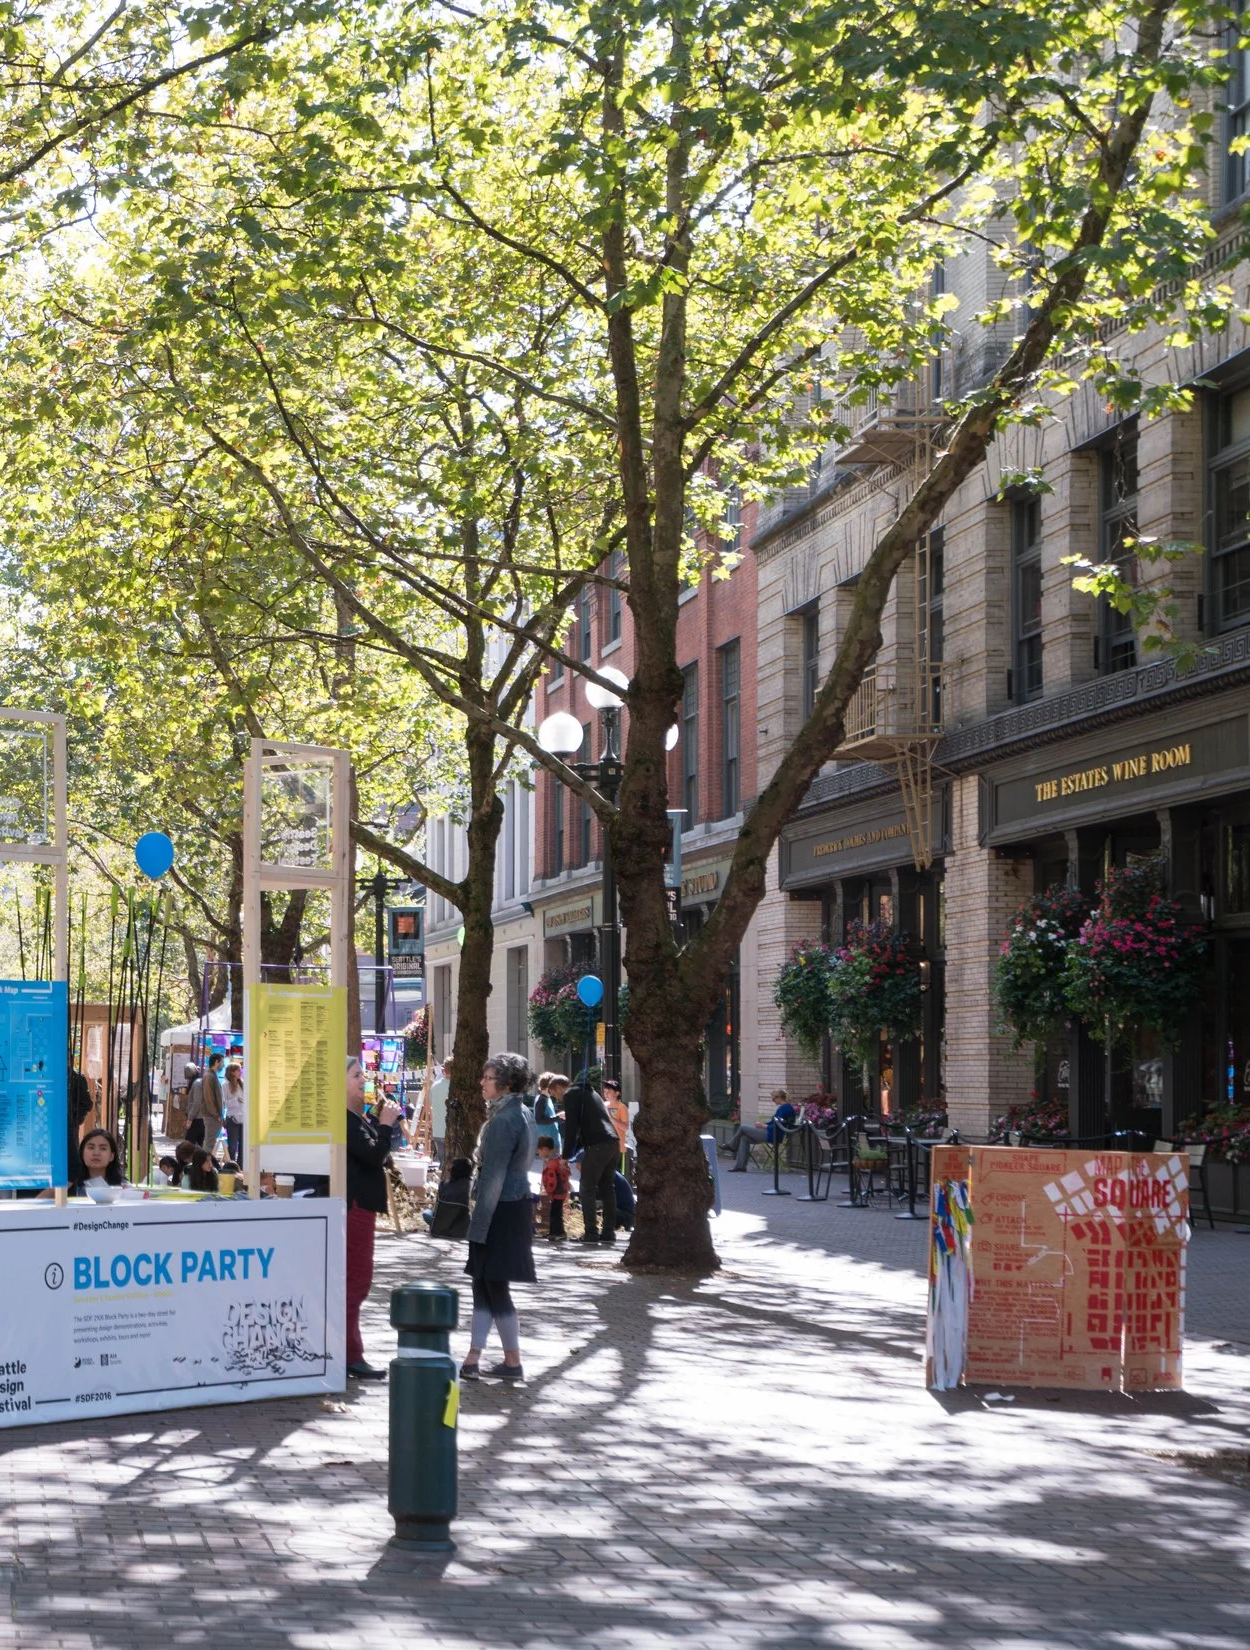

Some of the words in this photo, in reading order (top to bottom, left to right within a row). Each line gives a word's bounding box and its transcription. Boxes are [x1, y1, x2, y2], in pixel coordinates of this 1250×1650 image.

[1035, 780, 1057, 802] THE
[1061, 766, 1109, 795] ESTATES
[1112, 755, 1148, 782] WINE
[1151, 744, 1191, 773] ROOM
[4, 986, 19, 995] Map
[1013, 1154, 1039, 1163] SHAPE
[990, 1161, 1025, 1170] PIONEER
[1028, 1162, 1061, 1172] SQUARE
[1094, 1155, 1123, 1176] MAP
[1093, 1177, 1171, 1211] SQUARE
[73, 1221, 129, 1232] #DesignChange
[74, 1252, 174, 1290] BLOCK
[181, 1247, 275, 1283] PARTY
[996, 1279, 1013, 1288] THIS
[118, 1312, 130, 1320] Party
[75, 1391, 112, 1403] #SDF2016
